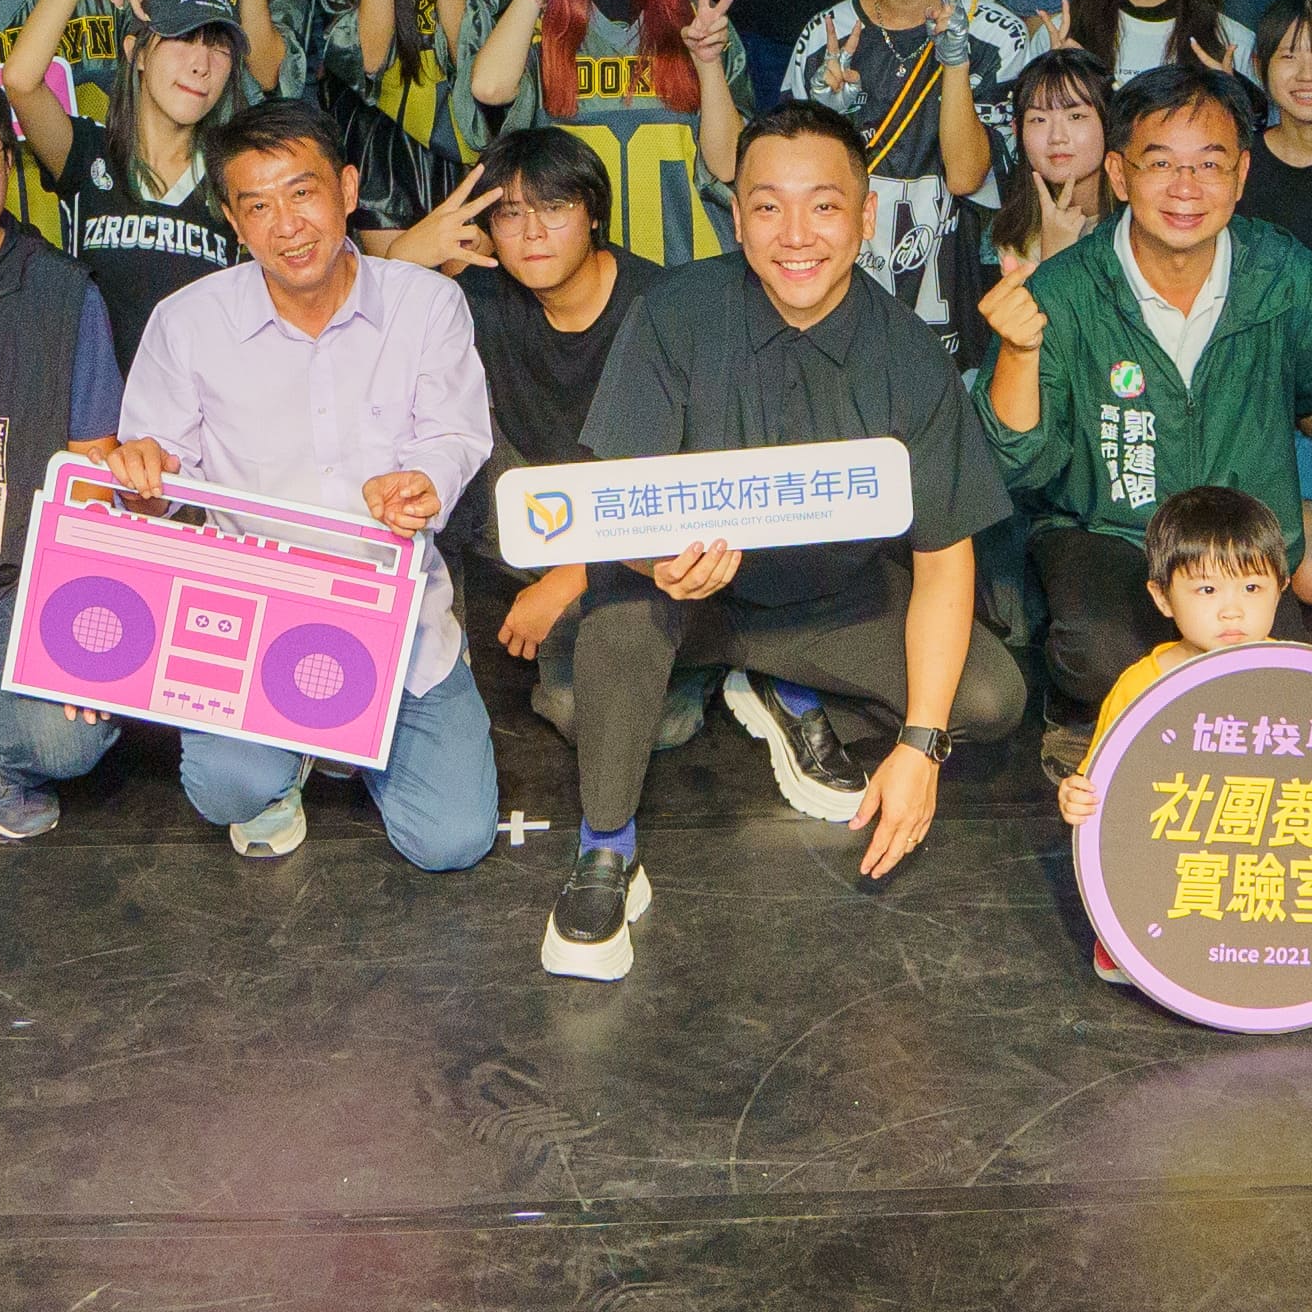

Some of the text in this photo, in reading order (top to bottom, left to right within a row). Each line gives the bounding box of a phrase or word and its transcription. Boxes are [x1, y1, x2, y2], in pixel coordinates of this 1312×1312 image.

[83, 214, 228, 269] ZEROCRICLE
[1122, 408, 1157, 510] 郭建盟
[591, 465, 880, 523] 高雄市政府青年局
[595, 526, 631, 538] YOUTH
[680, 517, 739, 532] KAOHSIUNG
[741, 515, 763, 526] CITY
[765, 509, 834, 525] GOVERNMENT
[1207, 943, 1312, 966] since 2021
